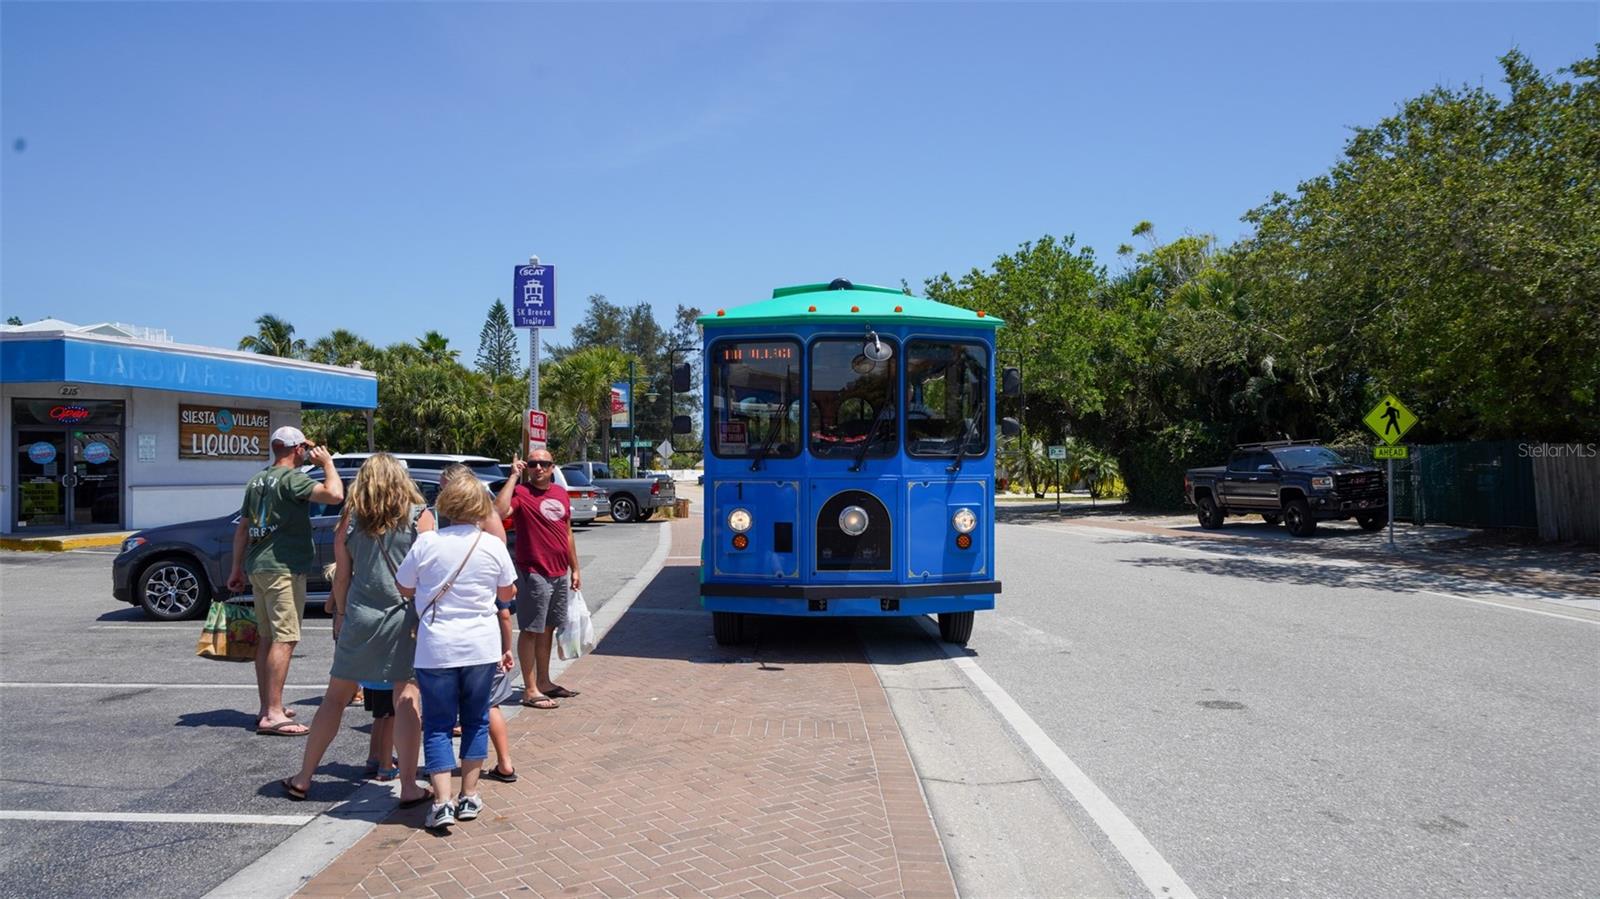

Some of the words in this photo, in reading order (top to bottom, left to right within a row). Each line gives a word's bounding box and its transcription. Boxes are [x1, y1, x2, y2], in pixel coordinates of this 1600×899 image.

[517, 308, 526, 316] SK
[527, 308, 551, 316] Breeze
[522, 317, 546, 326] Trolley
[61, 387, 79, 396] 215
[49, 405, 89, 420] Open
[182, 410, 217, 425] SIESTA
[231, 413, 268, 428] VILLAGE
[192, 433, 260, 457] LIQUORS
[1379, 448, 1404, 456] AHEAD
[252, 476, 279, 488] SATY
[736, 482, 743, 500] 1
[248, 525, 278, 537] CREW
